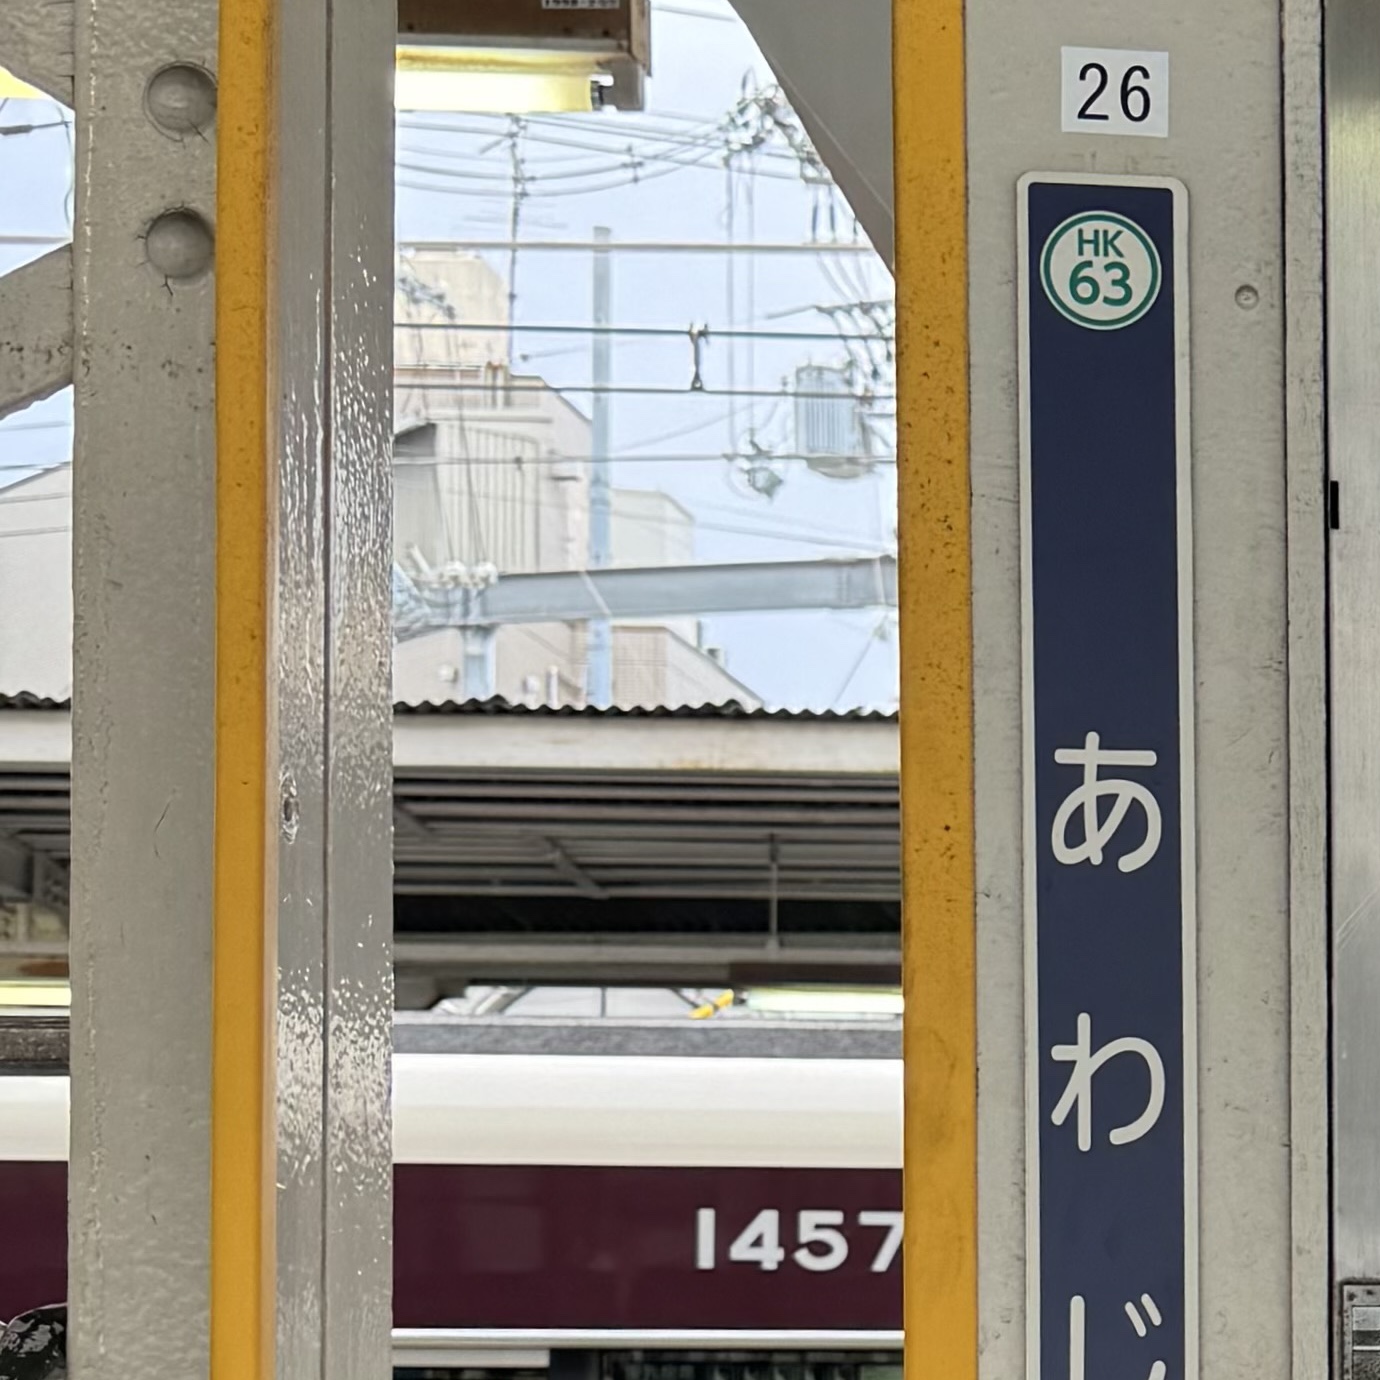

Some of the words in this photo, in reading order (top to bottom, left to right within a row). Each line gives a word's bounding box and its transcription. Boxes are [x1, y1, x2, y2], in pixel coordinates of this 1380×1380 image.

[1077, 62, 1151, 122] 26
[1078, 228, 1125, 258] HK
[1069, 260, 1133, 307] 63
[696, 1207, 905, 1272] 1457
